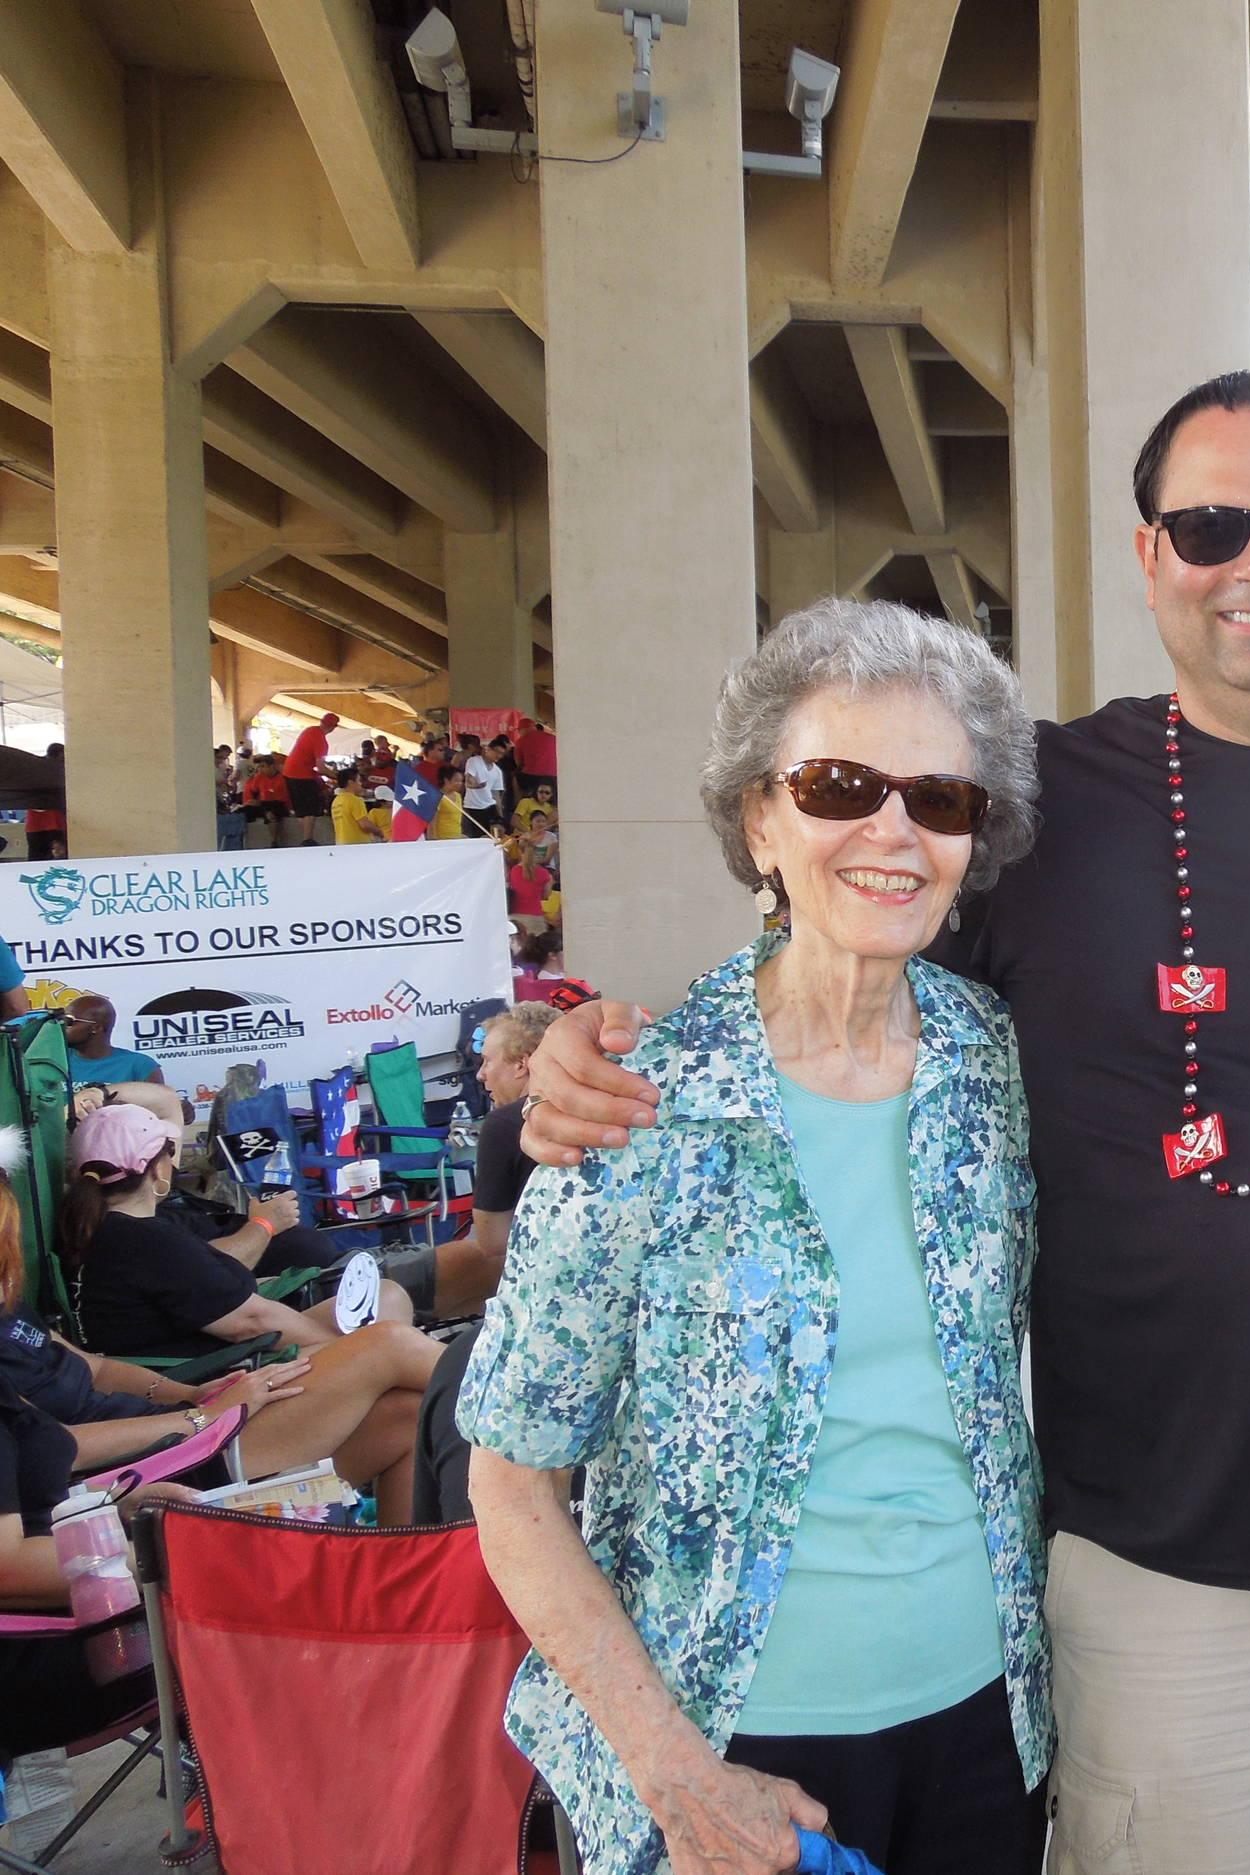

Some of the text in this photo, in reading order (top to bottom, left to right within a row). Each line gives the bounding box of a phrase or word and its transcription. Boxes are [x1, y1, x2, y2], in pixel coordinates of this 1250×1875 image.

[89, 866, 268, 899] CLEAR LAKE
[92, 888, 269, 916] DRAGON RIGHTS
[7, 912, 463, 965] THANKS TO OUR SPONSORS
[327, 997, 480, 1025] Extollo Marke
[138, 1027, 301, 1050] DEALER SERVICES
[156, 1041, 288, 1060] www.unisealusa.com
